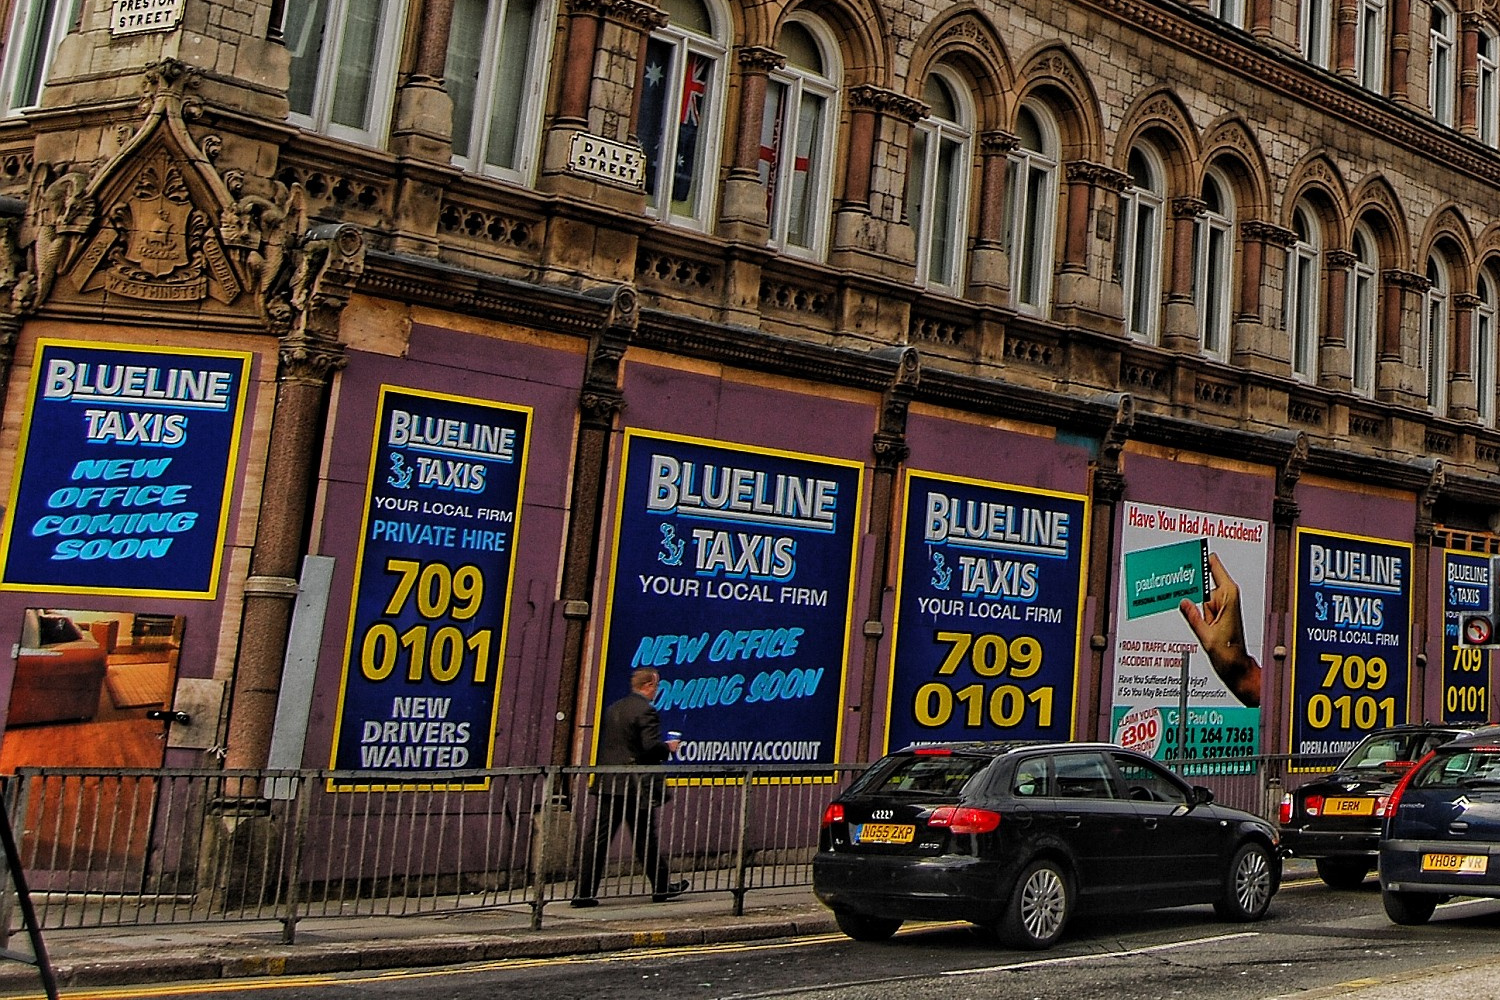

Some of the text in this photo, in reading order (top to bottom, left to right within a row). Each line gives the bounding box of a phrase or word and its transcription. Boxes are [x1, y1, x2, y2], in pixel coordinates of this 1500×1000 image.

[119, 10, 172, 28] STREET
[585, 142, 634, 165] DALE
[579, 156, 637, 179] STREET
[44, 359, 232, 403] BLUELINE
[85, 410, 187, 448] TAXIS
[388, 409, 516, 456] BLUELINE
[71, 457, 172, 481] NEW
[417, 457, 487, 494] TAXIS
[48, 485, 192, 508] OFFICE
[647, 454, 838, 521] BLUELINE
[375, 496, 513, 522] YOUR LOCAL FIRM
[924, 492, 1069, 548] BLUELINE
[31, 512, 198, 537] COMING
[372, 519, 506, 551] PRIVATE HIRE
[1129, 506, 1263, 543] Have You Had An Accident?
[51, 538, 173, 560] SOON
[692, 528, 797, 582] TAXIS
[1309, 544, 1402, 586] BLUELINE
[1447, 562, 1488, 583] BLUELINE
[385, 559, 484, 620] 709
[639, 574, 828, 607] YOUR LOCAL FIRM
[959, 556, 1039, 602] TAXIS
[1457, 588, 1480, 604] TAXIS
[918, 597, 1062, 623] YOUR LOCAL FIRM
[1332, 594, 1384, 630] TAXIS
[631, 627, 805, 668] NEW OFFICE
[1122, 640, 1198, 654] ROAD TRAFFIC ACCIDENT
[1307, 628, 1399, 646] YOUR LOCAL FIRM
[361, 623, 492, 682] 0101
[937, 632, 1042, 678] 709
[1121, 655, 1153, 666] ACCIDENT
[1154, 657, 1162, 667] AT
[1452, 645, 1482, 671] 709
[1118, 675, 1133, 684] Have
[1133, 675, 1143, 684] You
[1144, 675, 1167, 685] Suffered
[1320, 653, 1387, 690] 709
[651, 667, 824, 712] OMING SOON
[1123, 688, 1131, 696] So
[1132, 688, 1142, 696] You
[1143, 688, 1154, 699] May
[1155, 688, 1162, 696] Be
[1447, 685, 1485, 712] 0101
[392, 696, 451, 718] NEW
[914, 683, 1053, 727] 0101
[1140, 707, 1158, 720] YOUR
[1188, 710, 1208, 725] Paul
[1209, 710, 1223, 725] On
[1307, 693, 1395, 730] 0101
[361, 721, 471, 744] DRIVERS
[1122, 719, 1157, 747] £300
[1200, 727, 1223, 743] 264
[1226, 726, 1254, 743] 7363
[361, 745, 470, 768] WANTED
[676, 741, 756, 761] COMPANY
[751, 741, 821, 761] ACCOUNT
[1300, 741, 1321, 754] OPEN
[1322, 741, 1328, 754] A
[1430, 855, 1457, 867] YH08
